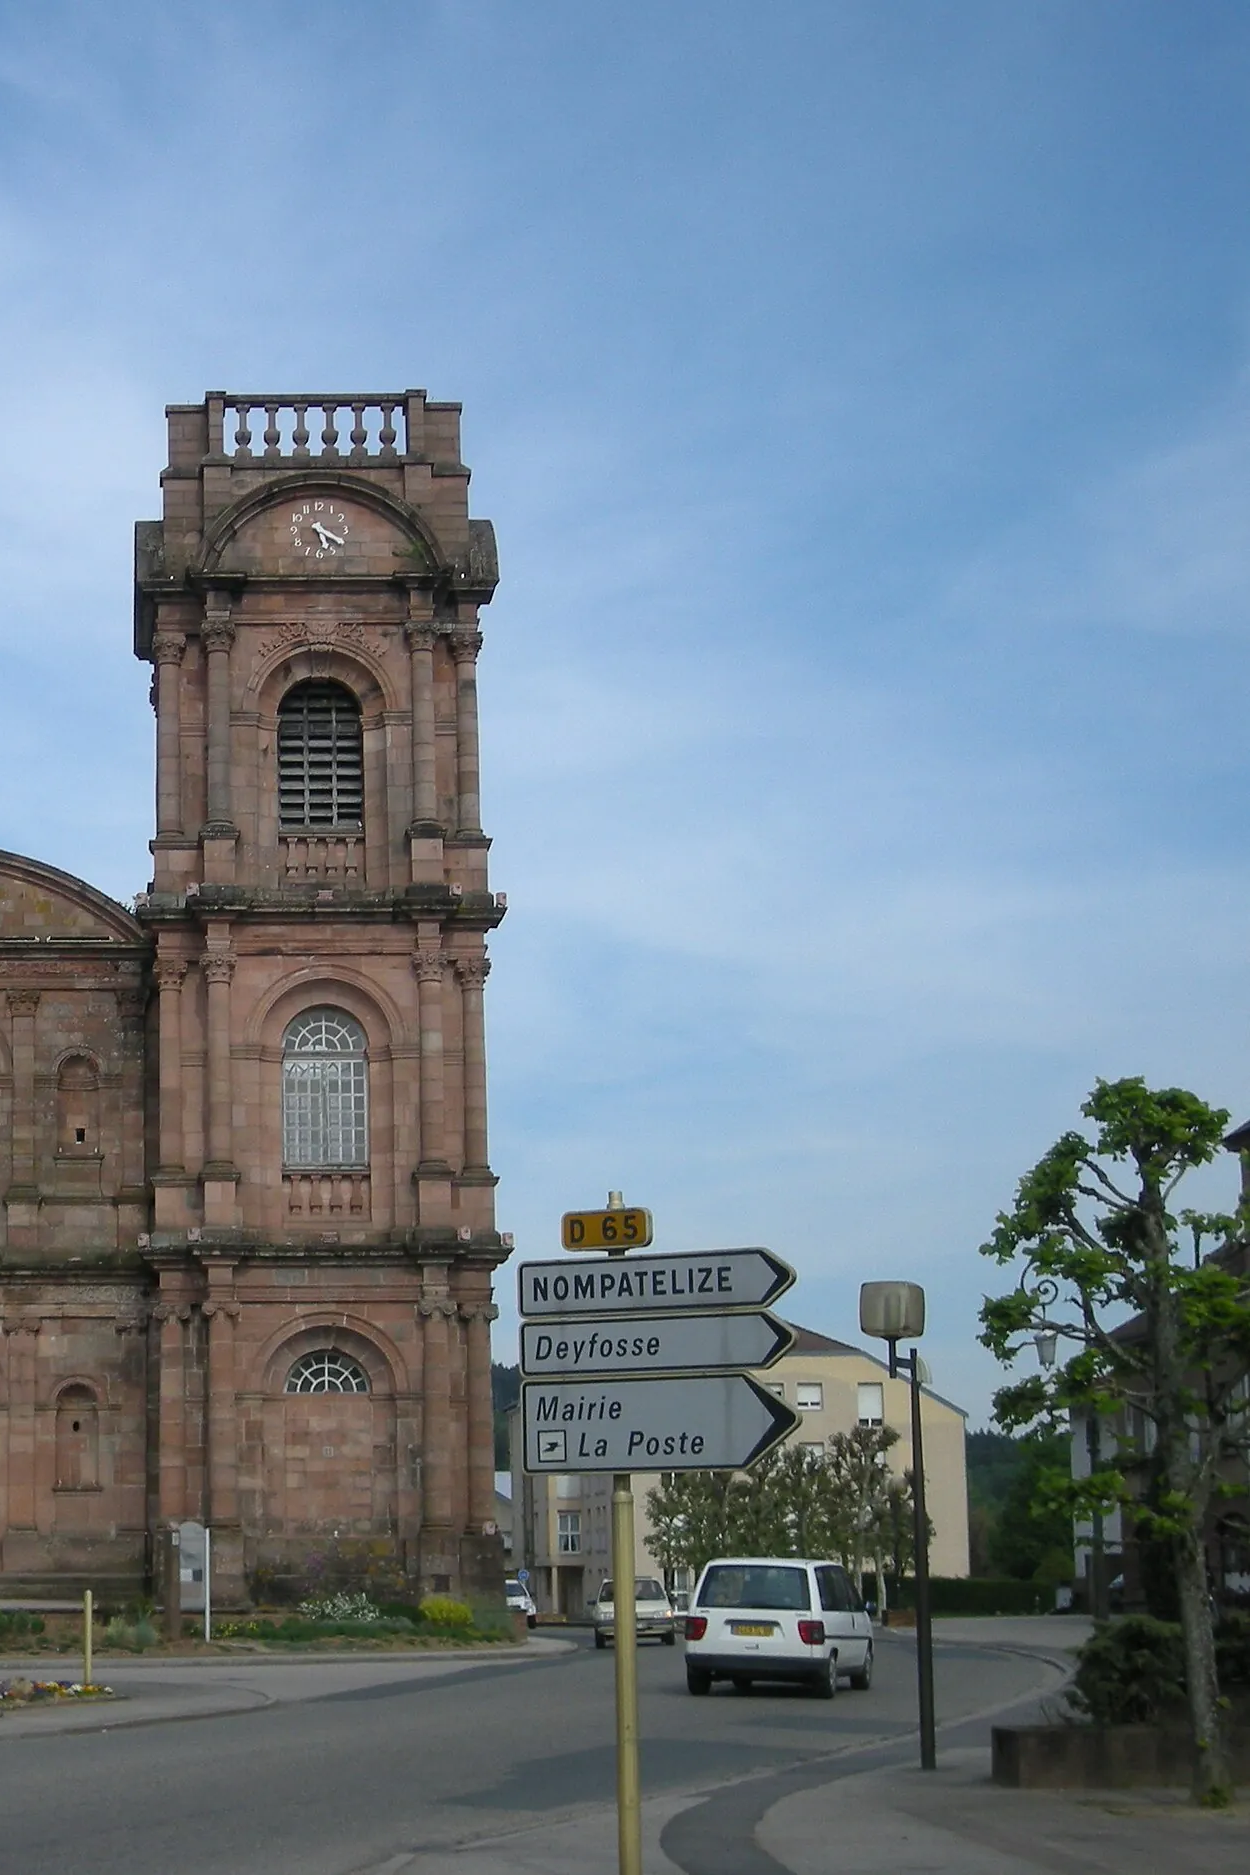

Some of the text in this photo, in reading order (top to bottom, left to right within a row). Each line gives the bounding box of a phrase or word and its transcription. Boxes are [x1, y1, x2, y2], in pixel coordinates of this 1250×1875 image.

[302, 505, 310, 514] 11
[314, 501, 324, 511] 12
[292, 513, 303, 522] 10
[337, 513, 345, 522] 2
[290, 526, 298, 535] 9
[343, 526, 349, 535] 3
[294, 538, 302, 547] 8
[305, 547, 311, 556] 7
[316, 549, 323, 559] 6
[330, 546, 336, 555] 5
[569, 1215, 638, 1244] D 65
[533, 1266, 733, 1302] NOMPATELIZE
[535, 1333, 660, 1364] Deyfosse
[536, 1396, 622, 1422] Mairie
[578, 1431, 705, 1458] La Poste
